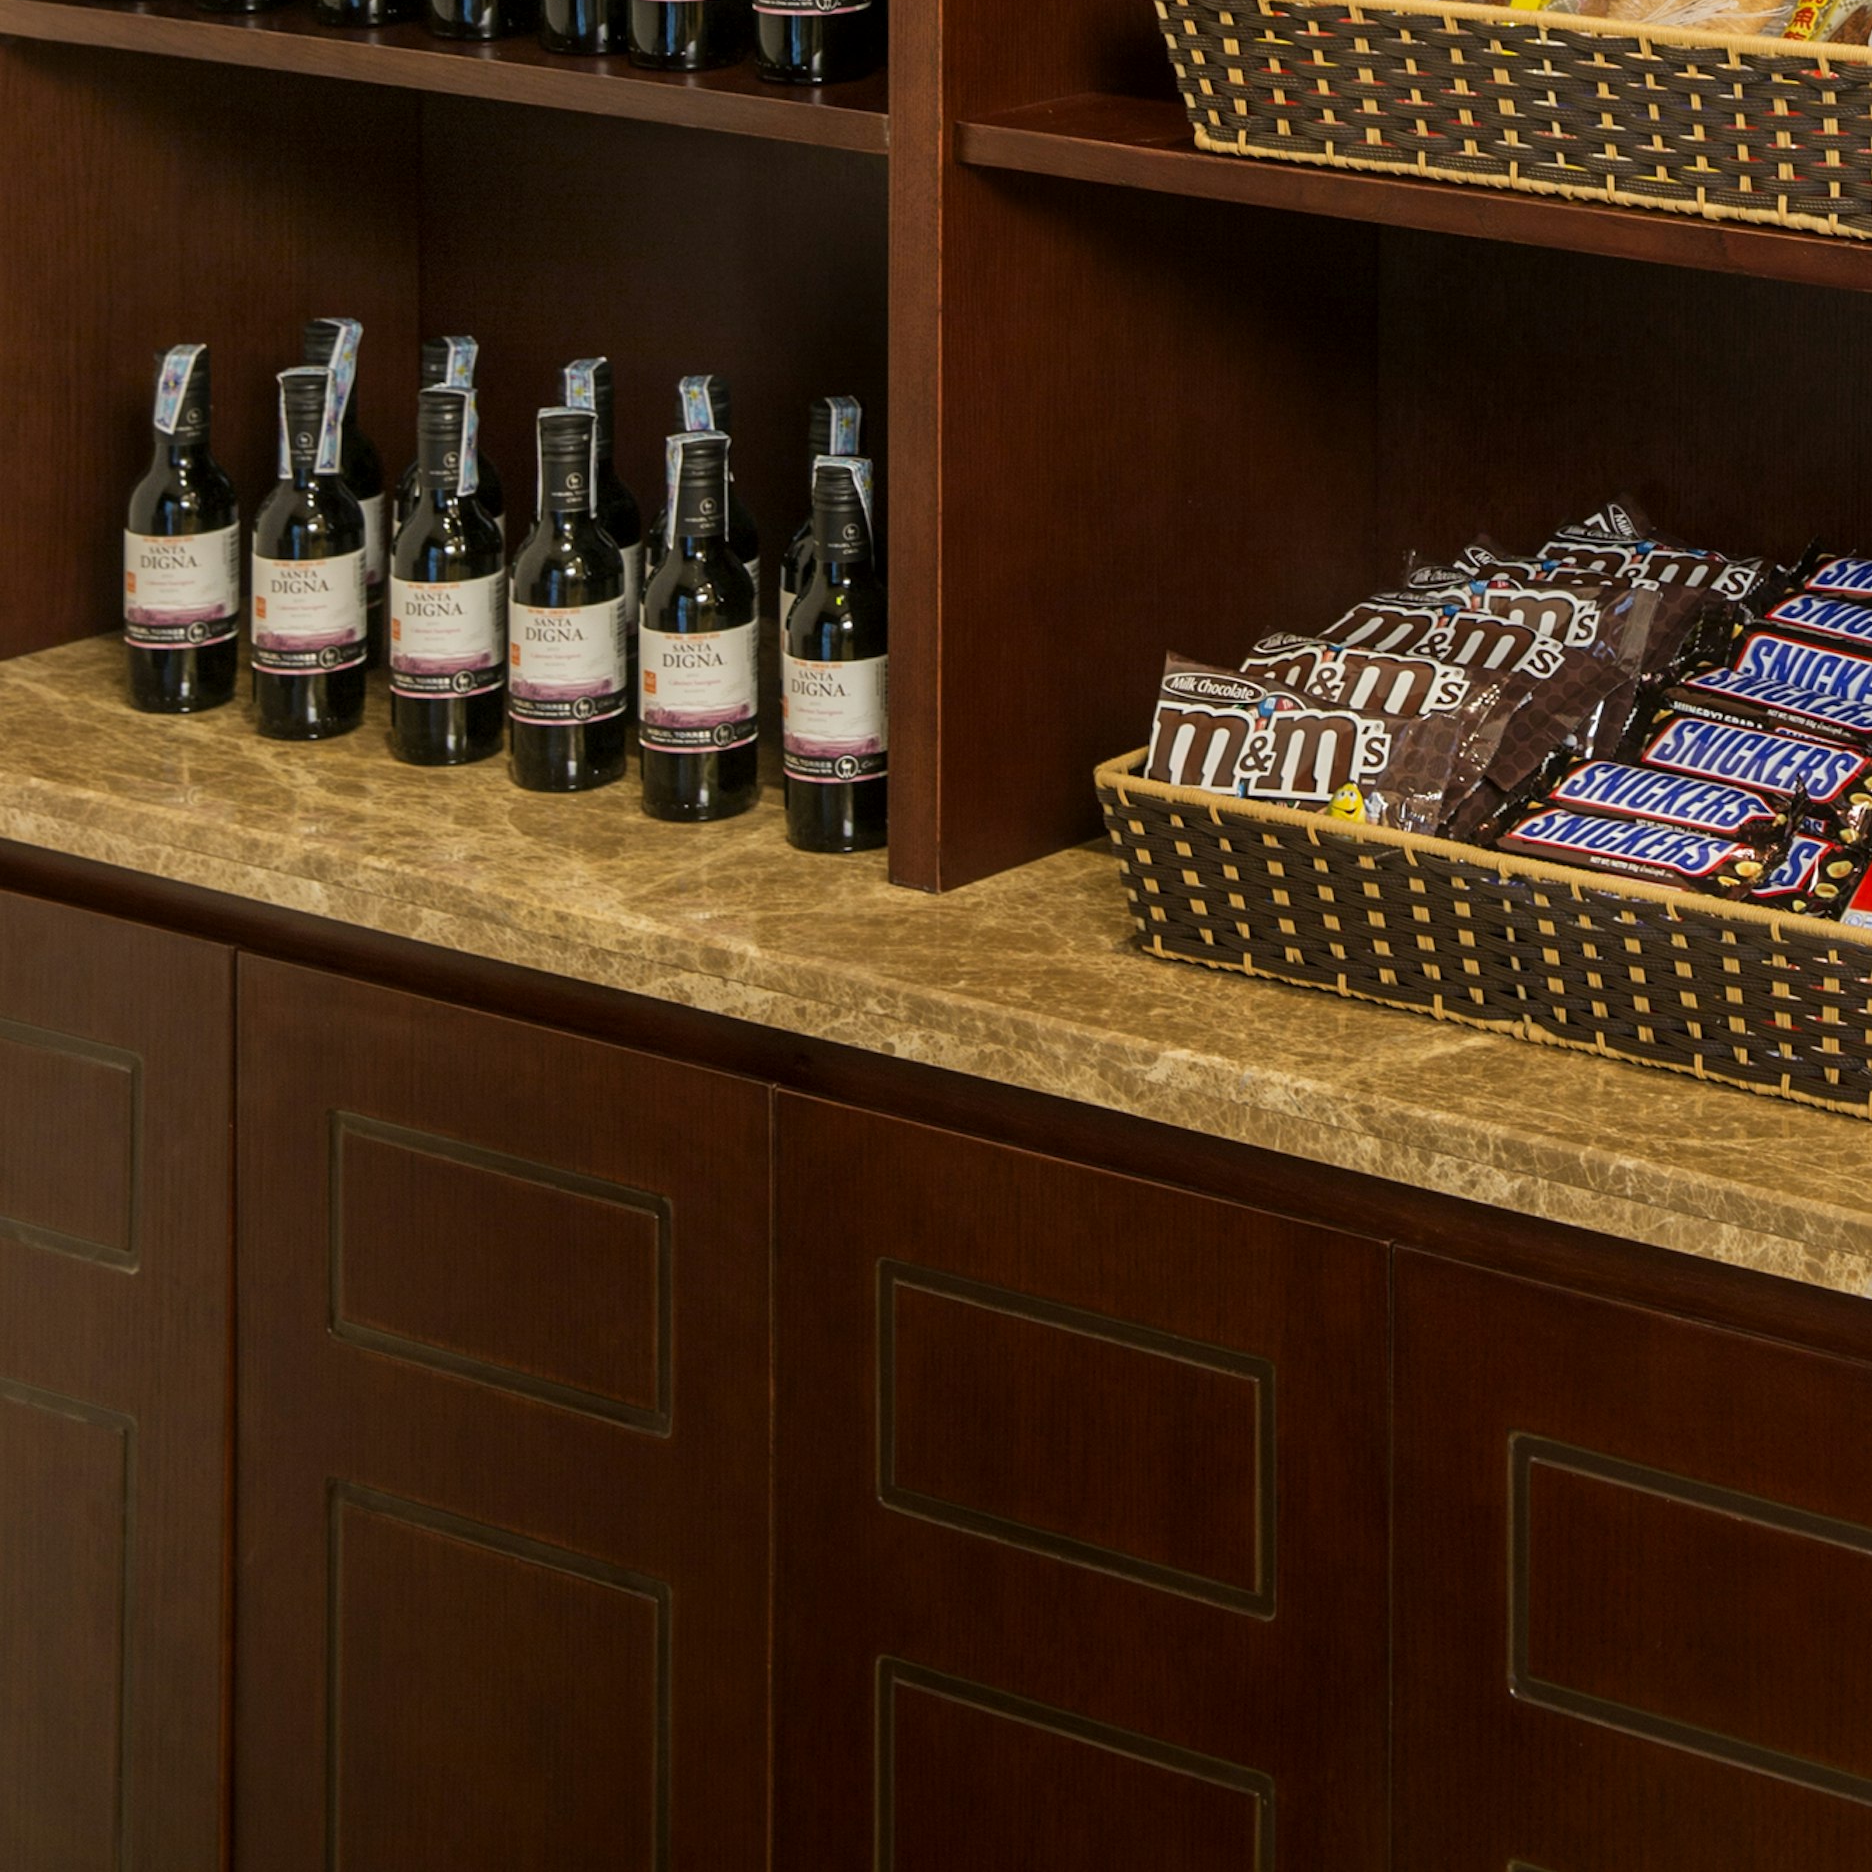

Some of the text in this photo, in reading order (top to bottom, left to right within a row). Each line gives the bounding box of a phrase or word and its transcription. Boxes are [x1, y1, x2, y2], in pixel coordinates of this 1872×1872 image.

[525, 627, 583, 642] DIGNA
[673, 643, 711, 653] SANTA
[663, 652, 723, 667] DIGNA
[1170, 676, 1256, 701] Milk Chocolate
[1657, 720, 1862, 800] SNICKERS
